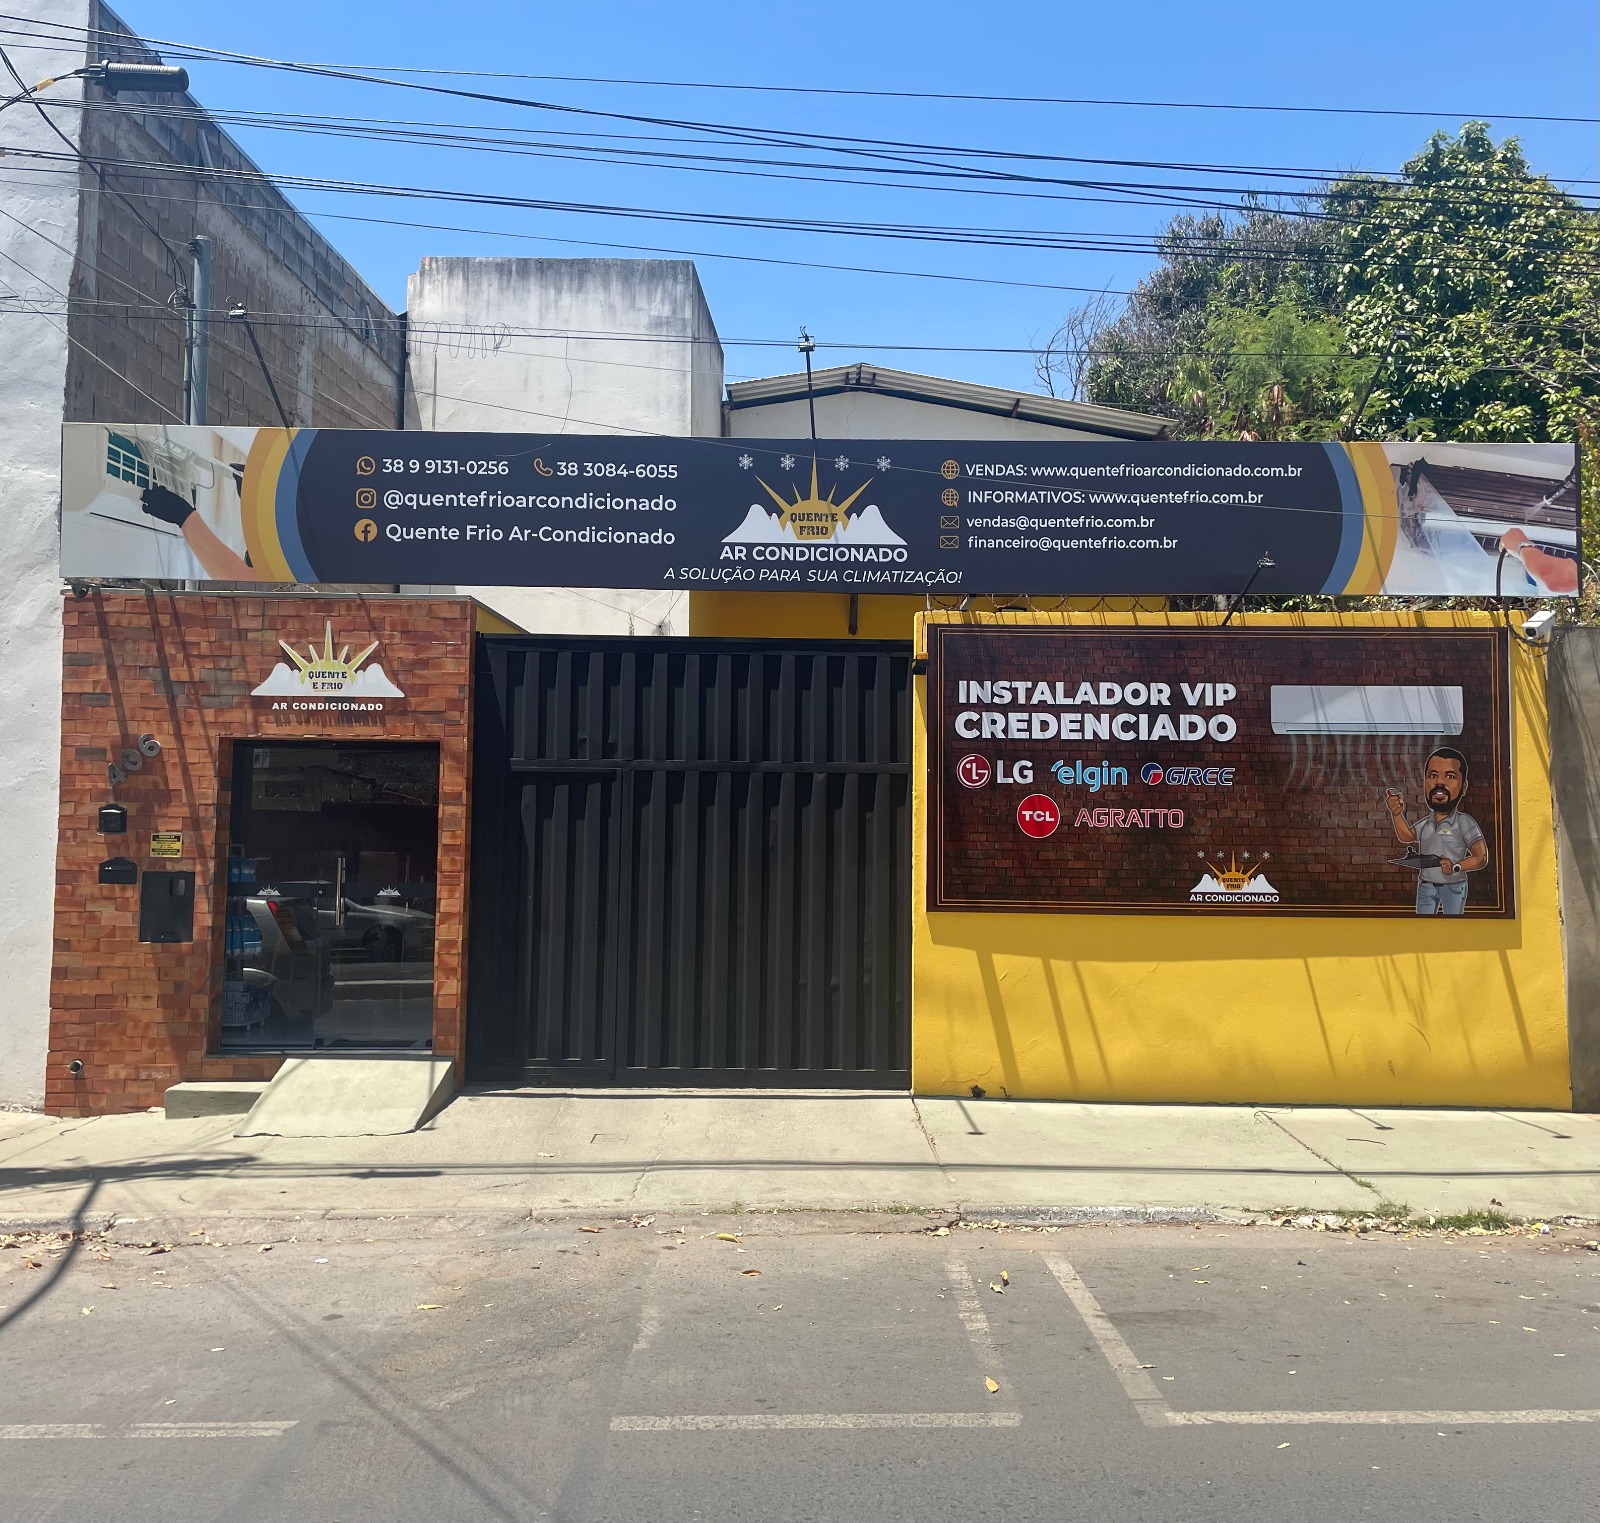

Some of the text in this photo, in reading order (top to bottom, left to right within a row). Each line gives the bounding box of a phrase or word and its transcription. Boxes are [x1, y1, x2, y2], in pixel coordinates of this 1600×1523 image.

[382, 458, 509, 475] 38 9 9131-0256
[556, 461, 678, 479] 38 3084-6055
[965, 463, 1303, 480] VENDAS: www.quentefrioarcondicionado.com.br
[383, 489, 677, 512] @quentefrioarcondicionado
[967, 489, 1264, 507] INFORMATIVOS: www.quentefrio.com.br
[789, 512, 838, 523] QUENTE
[966, 515, 1156, 531] vendas@quentefrio.com.br
[385, 523, 676, 545] Quente Frio Ar-Condicionado
[798, 525, 829, 536] FRIO
[967, 536, 1179, 552] financeiro@quentefrio.com.br
[719, 544, 909, 563] AR CONDICIONADO
[663, 565, 964, 588] A SOLUÇÃO PARA SUA CLIMATIZAÇÃO!
[308, 671, 348, 680] QUENTE
[312, 682, 343, 690] E FRIO
[958, 680, 1237, 707] INSTALADOR VIP
[271, 702, 384, 712] AR CONDICIONADO
[954, 710, 1237, 742] CREDENCIADO
[996, 759, 1034, 784] LG
[1052, 760, 1128, 792] elgin
[1166, 766, 1236, 786] GREE
[1021, 810, 1055, 822] TCL
[1074, 807, 1184, 829] AGRATTO
[1189, 894, 1280, 903] AR CONDICIONADO
